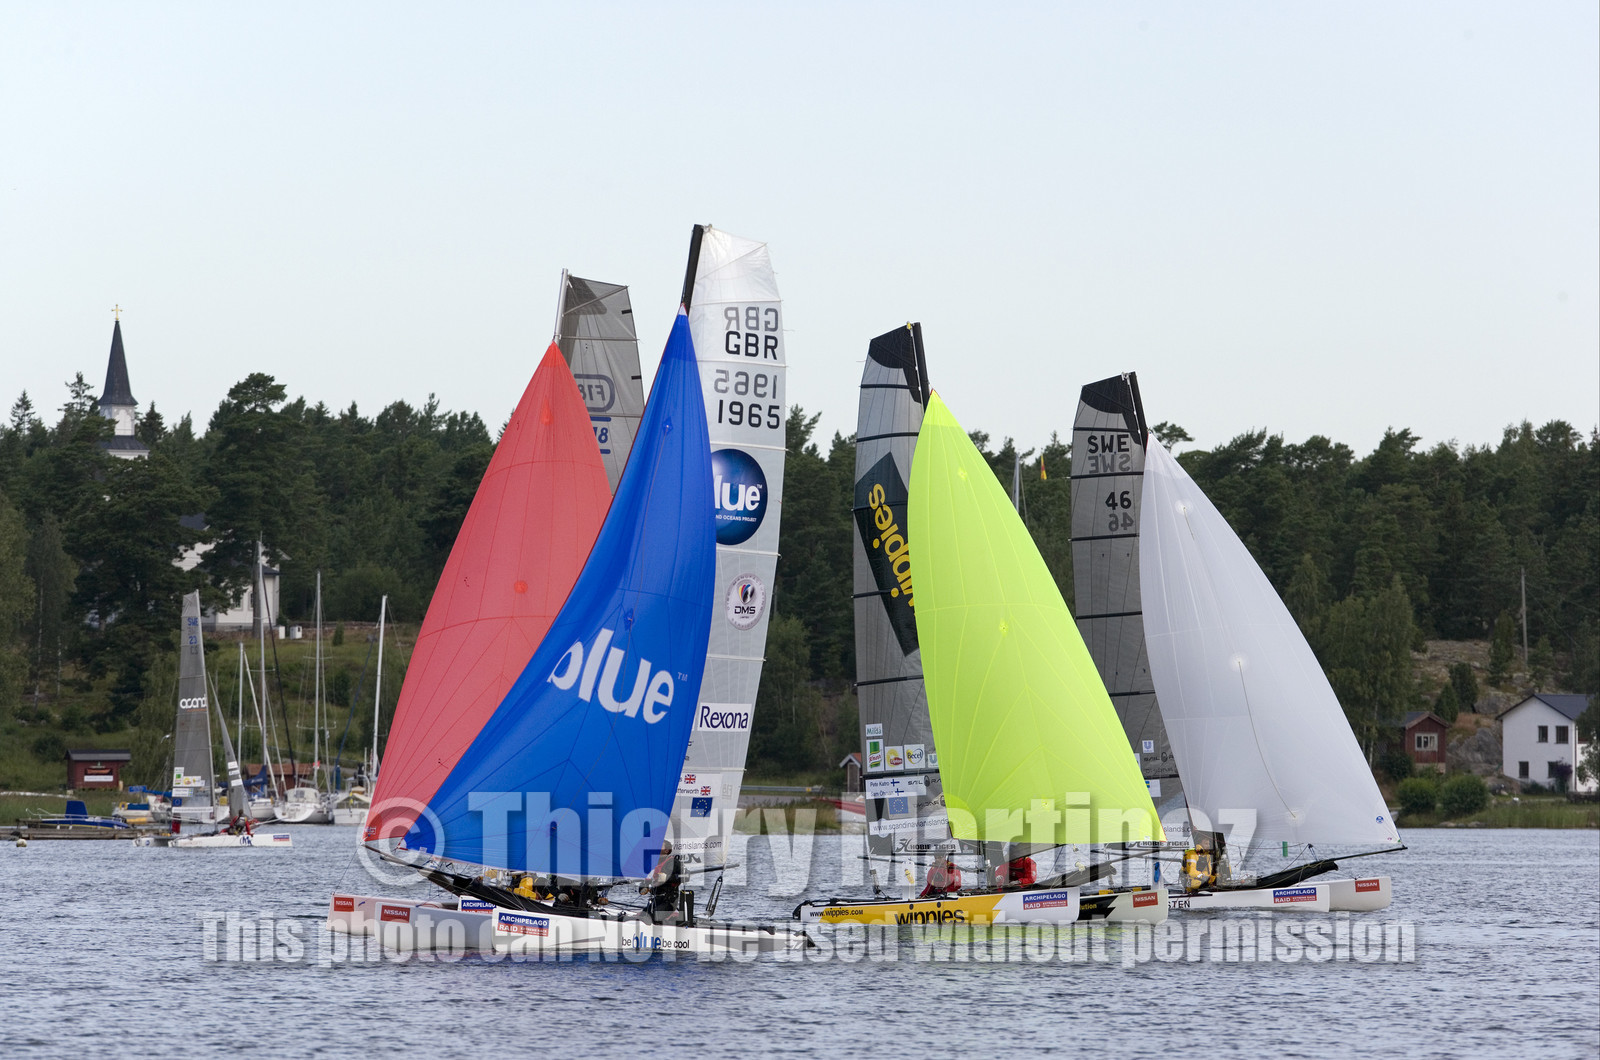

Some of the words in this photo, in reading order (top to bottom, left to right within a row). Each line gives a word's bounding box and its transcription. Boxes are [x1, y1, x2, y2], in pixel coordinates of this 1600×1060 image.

[725, 330, 778, 360] GBR
[717, 399, 780, 429] 1965
[1087, 434, 1129, 454] SWE
[1105, 491, 1132, 510] 46
[868, 483, 916, 607] ippies
[734, 606, 756, 614] DMS
[189, 635, 198, 645] 23
[547, 627, 675, 724] blue
[699, 705, 749, 729] Rexona
[907, 751, 922, 759] Becel
[1025, 893, 1066, 902] ARCHIPELAGO
[383, 908, 408, 917] NISSAN
[500, 915, 548, 926] ARCHIPELAGO
[894, 901, 965, 925] wippies
[499, 924, 518, 932] RAID
[622, 936, 631, 947] be
[662, 938, 672, 948] be
[673, 939, 690, 949] cool
